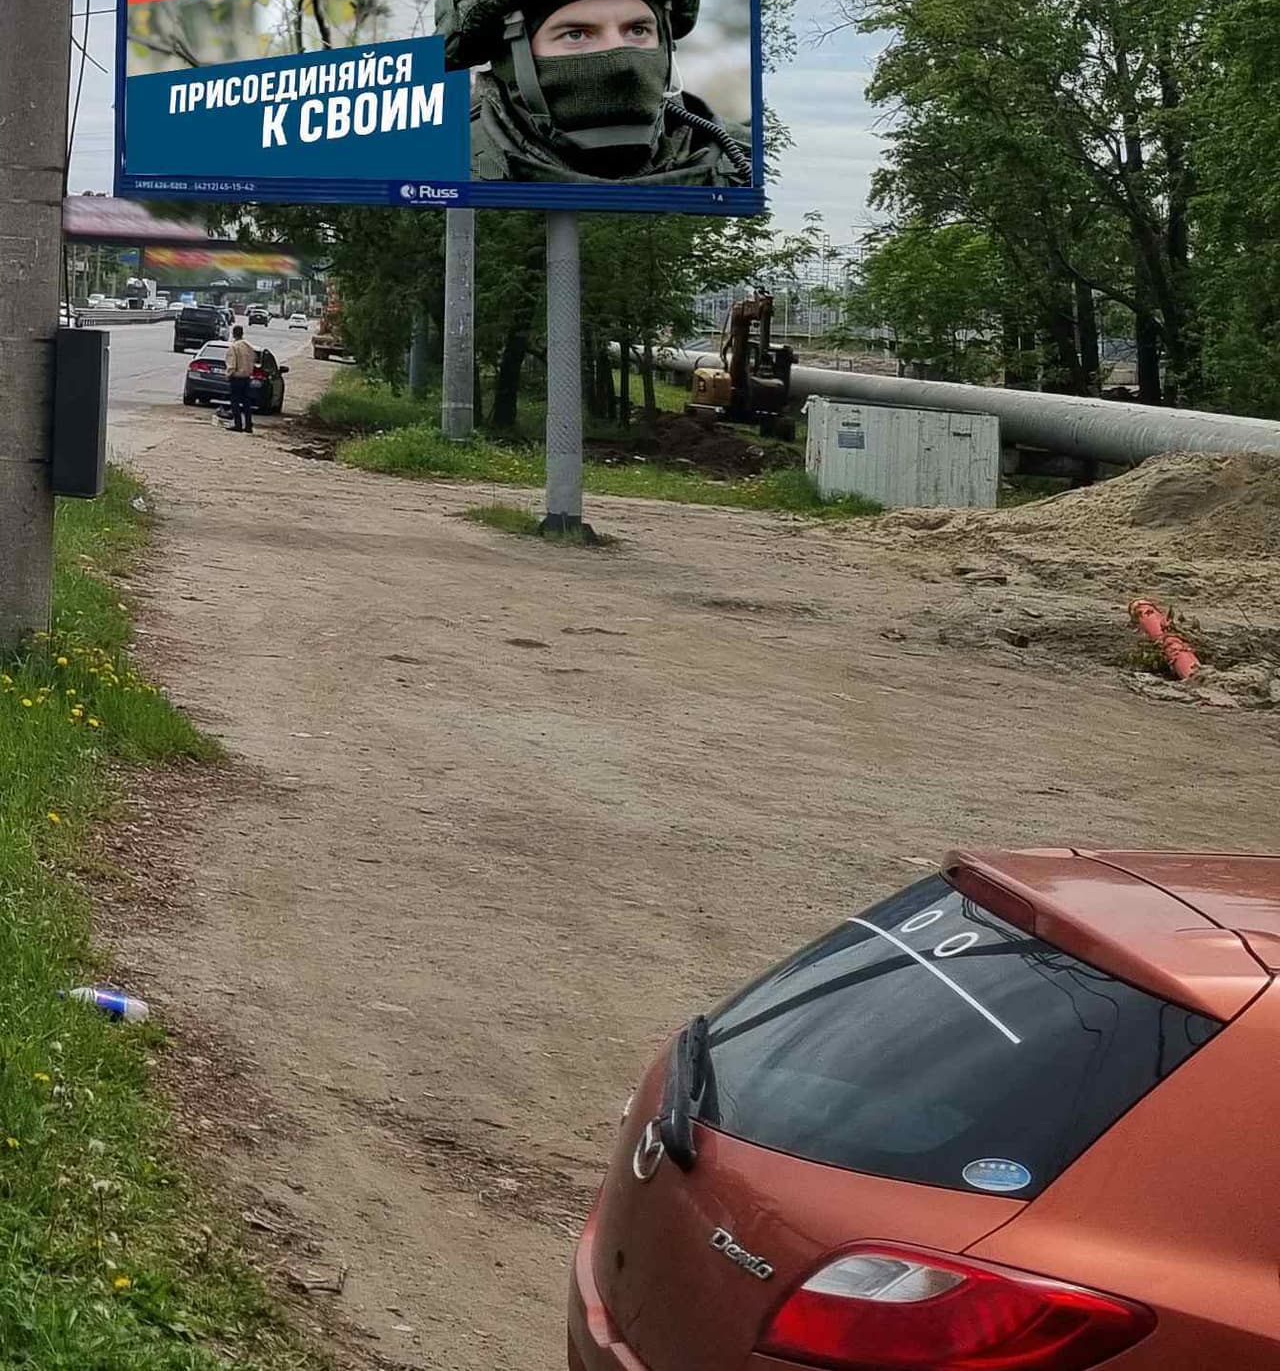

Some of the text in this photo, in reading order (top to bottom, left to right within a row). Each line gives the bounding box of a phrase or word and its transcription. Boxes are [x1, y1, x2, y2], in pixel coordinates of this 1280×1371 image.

[168, 51, 414, 115] ПРИСОЕДИНЯЙСЯ
[262, 82, 446, 149] К СВОИМ
[419, 185, 459, 198] Russ
